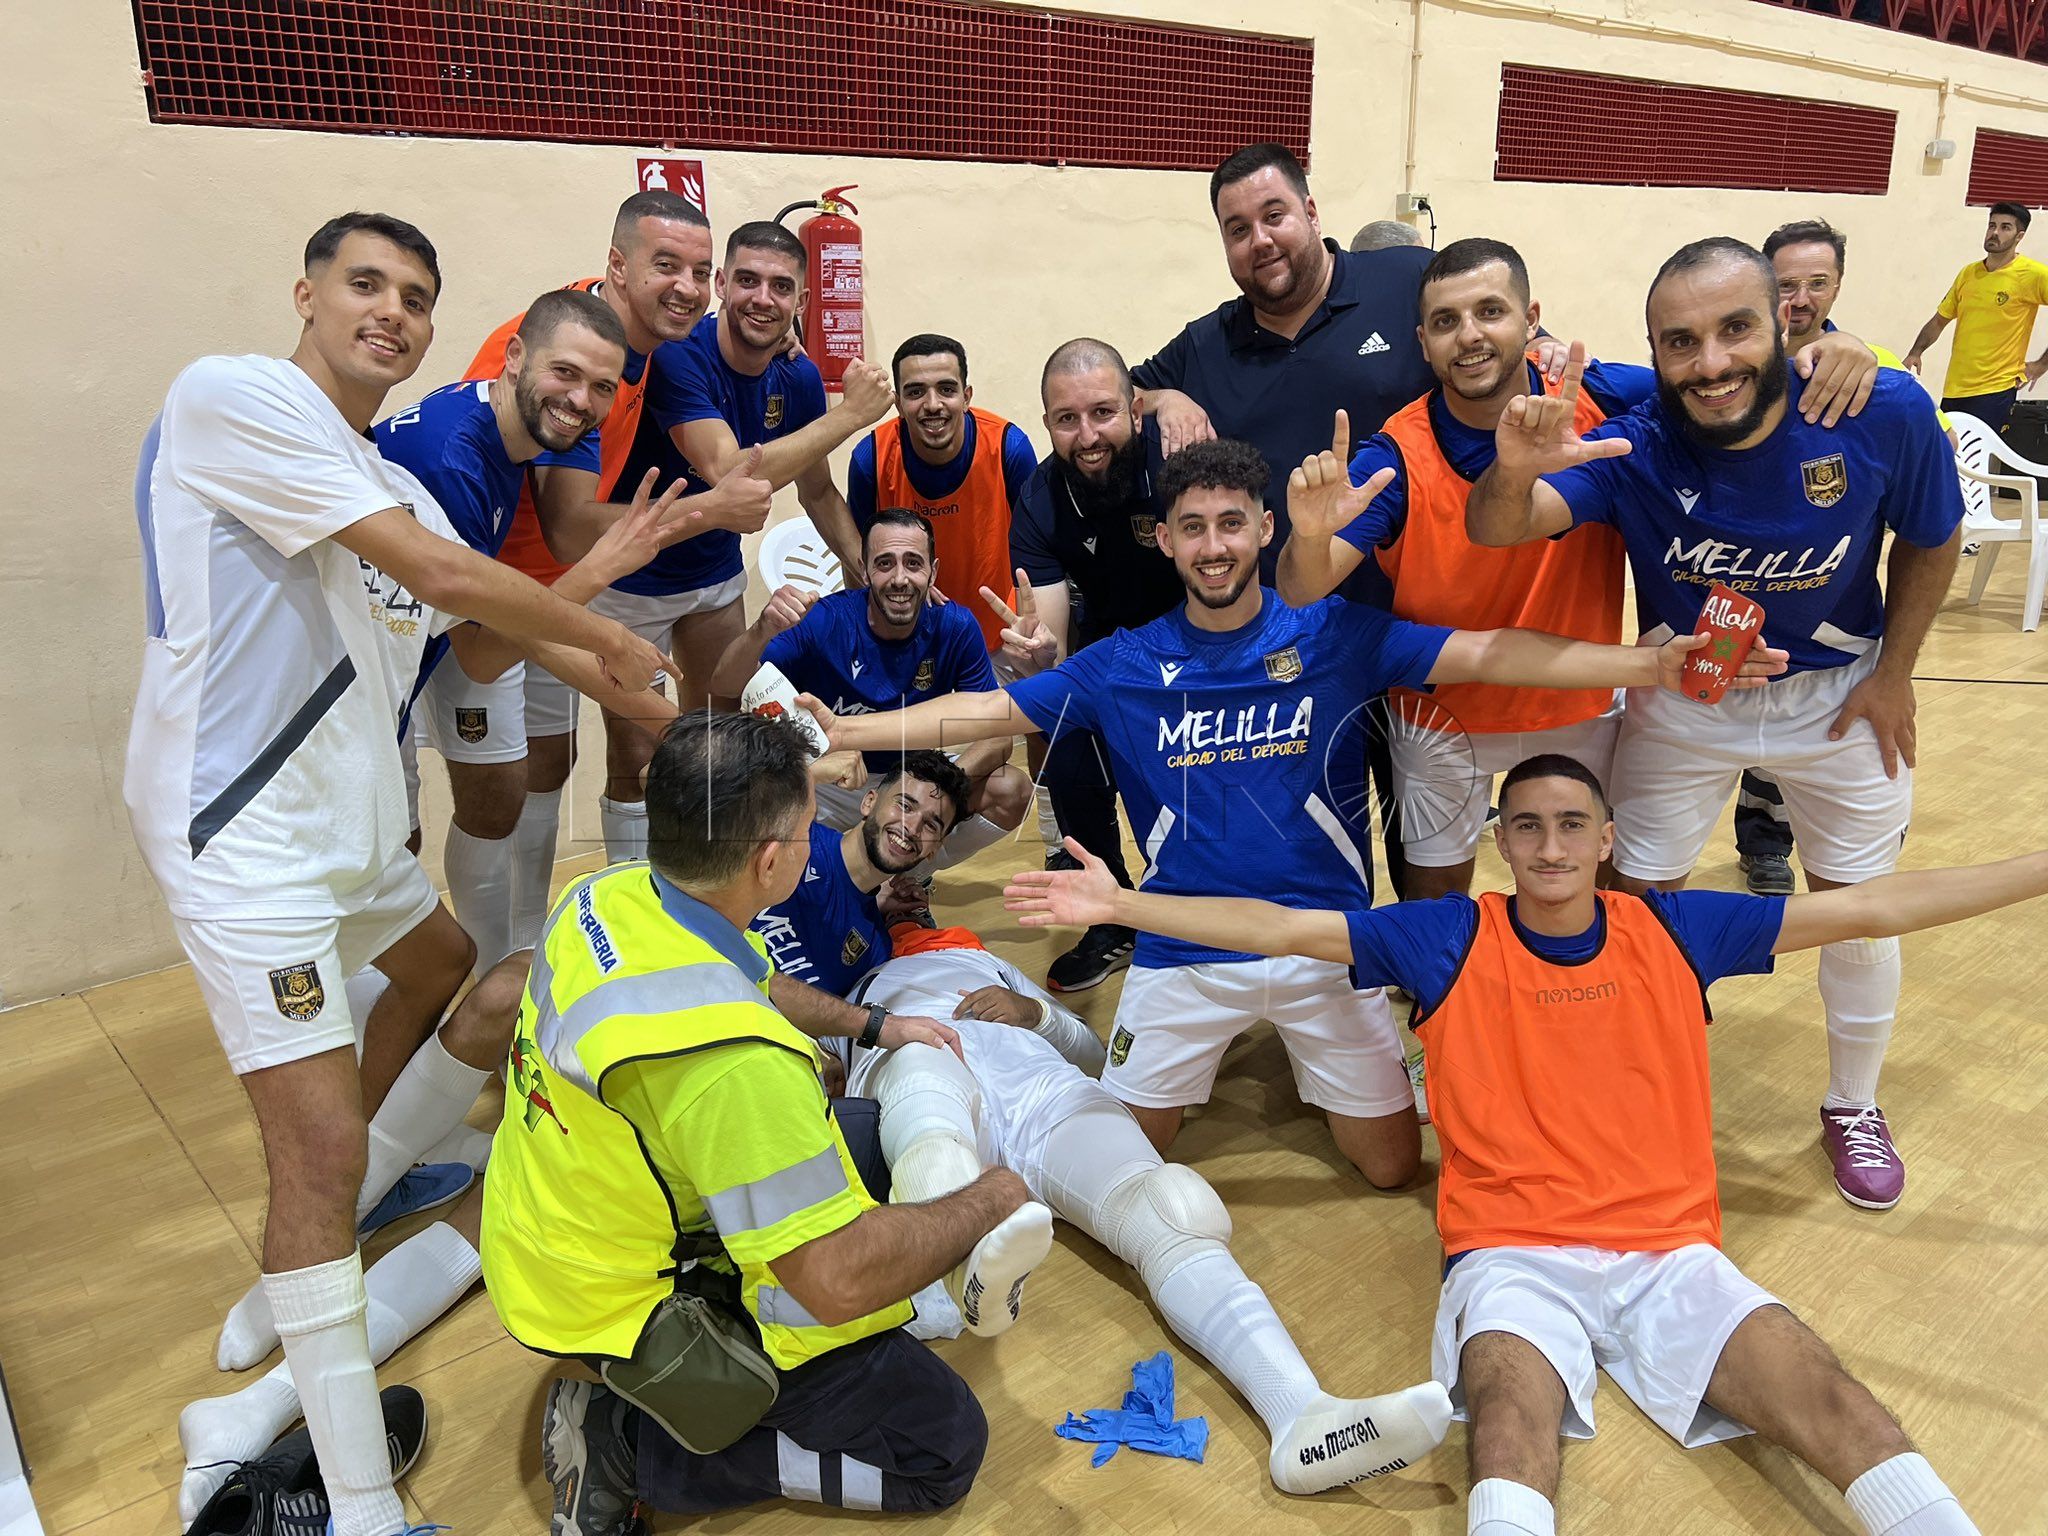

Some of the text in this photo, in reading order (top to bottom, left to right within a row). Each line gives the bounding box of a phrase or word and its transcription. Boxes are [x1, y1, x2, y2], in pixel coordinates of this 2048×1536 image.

[1358, 344, 1391, 355] adidas
[913, 501, 960, 517] macron
[1663, 535, 1852, 579] MELILLA
[1730, 579, 1760, 592] DEL
[1765, 574, 1833, 592] DEPORTE
[1157, 696, 1313, 751] MELILLA
[1166, 740, 1310, 769] CIUDAD DEL DEPORTE
[578, 884, 618, 974] ENFERMERIA
[1299, 1416, 1380, 1466] 43/46 macron
